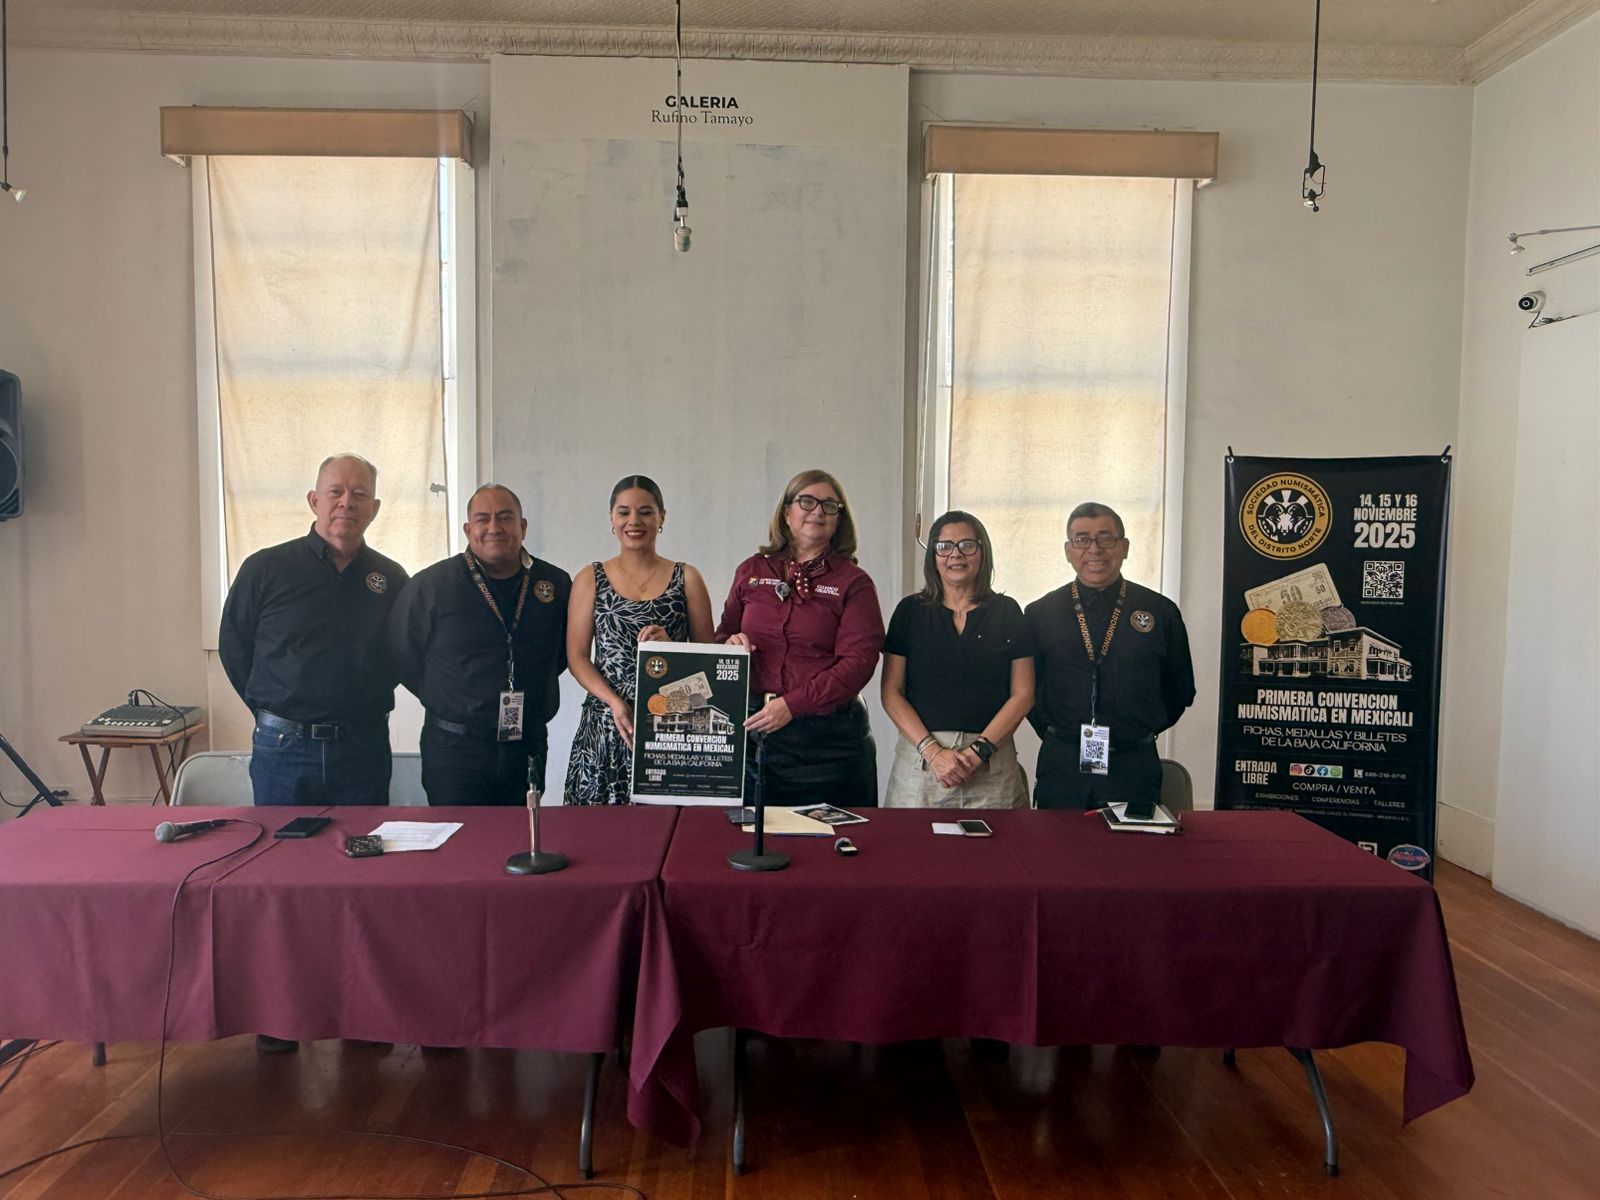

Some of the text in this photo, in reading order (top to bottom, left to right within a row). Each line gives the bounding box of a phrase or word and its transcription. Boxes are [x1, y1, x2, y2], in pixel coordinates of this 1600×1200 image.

[665, 95, 739, 109] GALERIA
[651, 109, 754, 126] Rufino Tamayo
[1247, 481, 1278, 515] SOCIEDAD
[1360, 494, 1418, 508] 14, 15 Y 16
[1354, 508, 1417, 521] NOVIEMBRE
[1248, 524, 1321, 553] DEL DISTRITO NORTE
[1354, 522, 1416, 548] 2025
[716, 670, 739, 680] 2025
[1257, 689, 1398, 710] PRIMERA CONVENCION
[1238, 704, 1413, 727] NUMISMATICA EN MEXICALI
[655, 733, 727, 744] PRIMERA CONVENCION
[1243, 725, 1407, 742] FICHAS, MEDALLAS Y BILLETES
[645, 741, 734, 753] NUMISMATICA EN MEXICALI
[1261, 736, 1386, 752] DE LA BAJA CALIFORNIA
[1235, 760, 1277, 774] ENTRADA
[1242, 773, 1269, 785] LIBRE
[1292, 782, 1334, 792] COMPRA
[1343, 786, 1376, 795] VENTA
[1312, 796, 1360, 805] CONFERENCIAS
[1374, 800, 1406, 808] TALLERES
